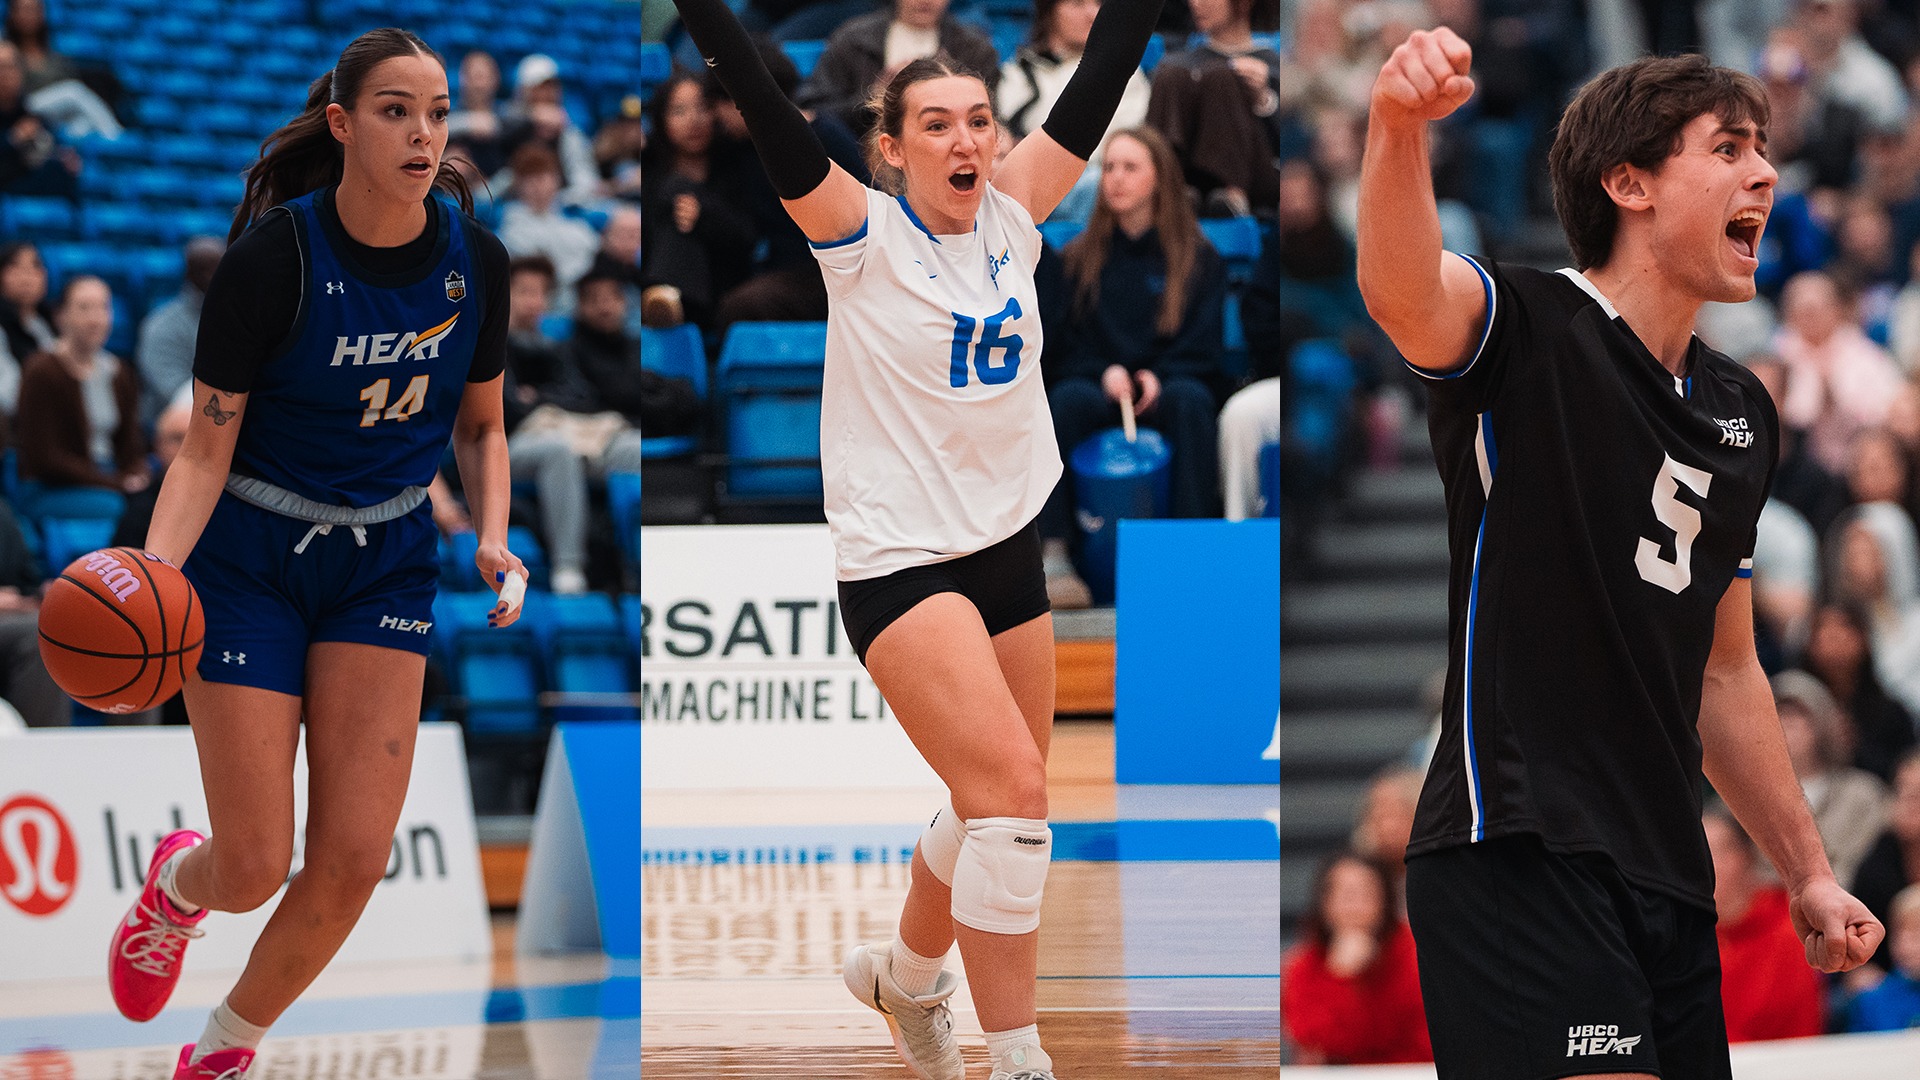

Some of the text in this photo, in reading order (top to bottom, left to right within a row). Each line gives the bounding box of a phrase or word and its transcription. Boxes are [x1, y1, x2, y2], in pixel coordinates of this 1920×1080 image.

[448, 287, 464, 298] WEST
[329, 311, 461, 366] HEAT
[950, 297, 1024, 388] 16
[359, 374, 430, 428] 14
[1634, 450, 1713, 595] 5
[379, 614, 433, 635] HEAT
[641, 680, 831, 721] MACHINE
[1566, 1034, 1642, 1057] HEAT
[1568, 1024, 1619, 1038] UBCO
